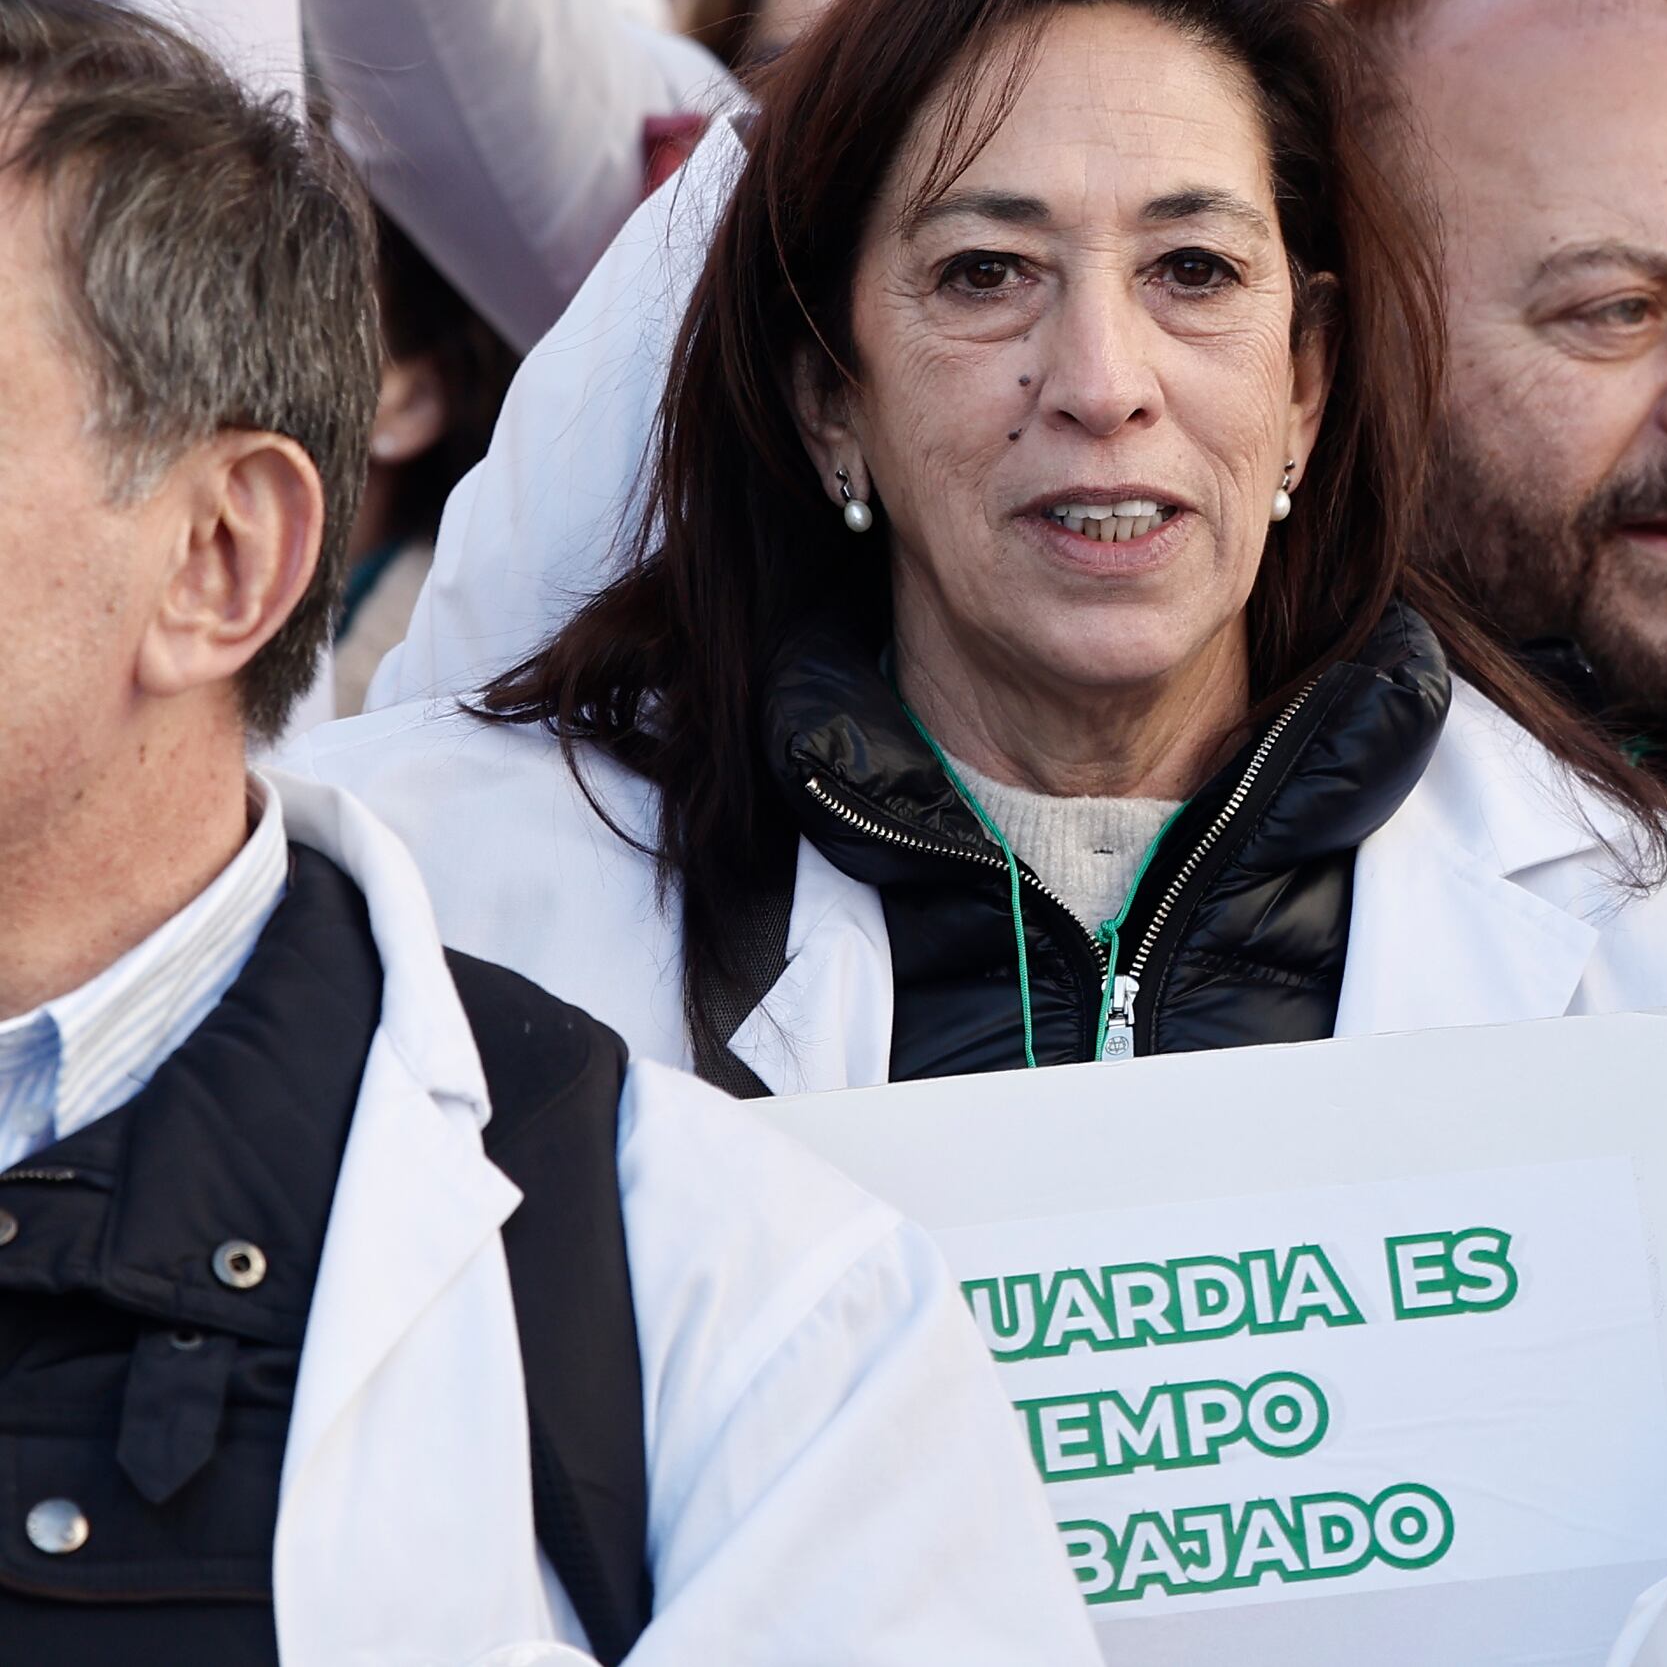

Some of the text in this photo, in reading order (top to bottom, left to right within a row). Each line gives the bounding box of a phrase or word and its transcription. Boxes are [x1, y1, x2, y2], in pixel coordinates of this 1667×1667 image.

[961, 1227, 1518, 1360] UARDIA ES
[1014, 1373, 1329, 1480] IEMPO
[1056, 1482, 1455, 1604] BAJADO
